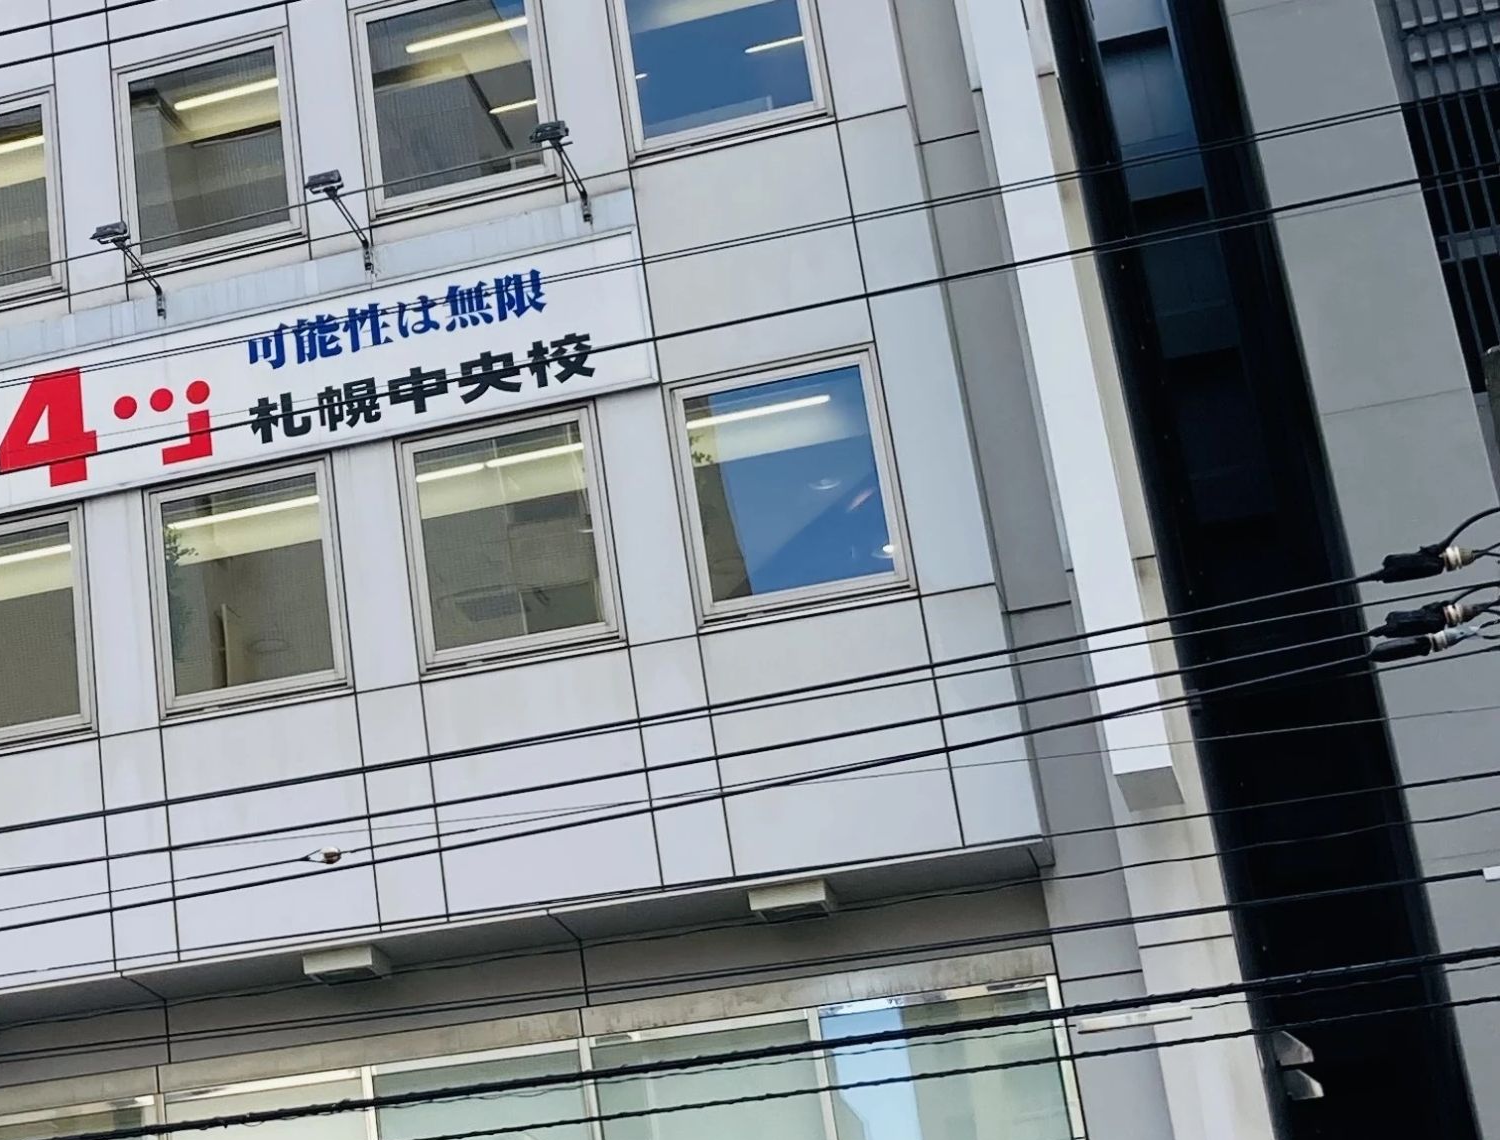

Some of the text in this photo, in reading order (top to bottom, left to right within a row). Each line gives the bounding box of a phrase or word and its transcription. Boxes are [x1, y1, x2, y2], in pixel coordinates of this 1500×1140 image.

[248, 268, 547, 372] 可能性は無限
[248, 331, 597, 445] 札幌中央校
